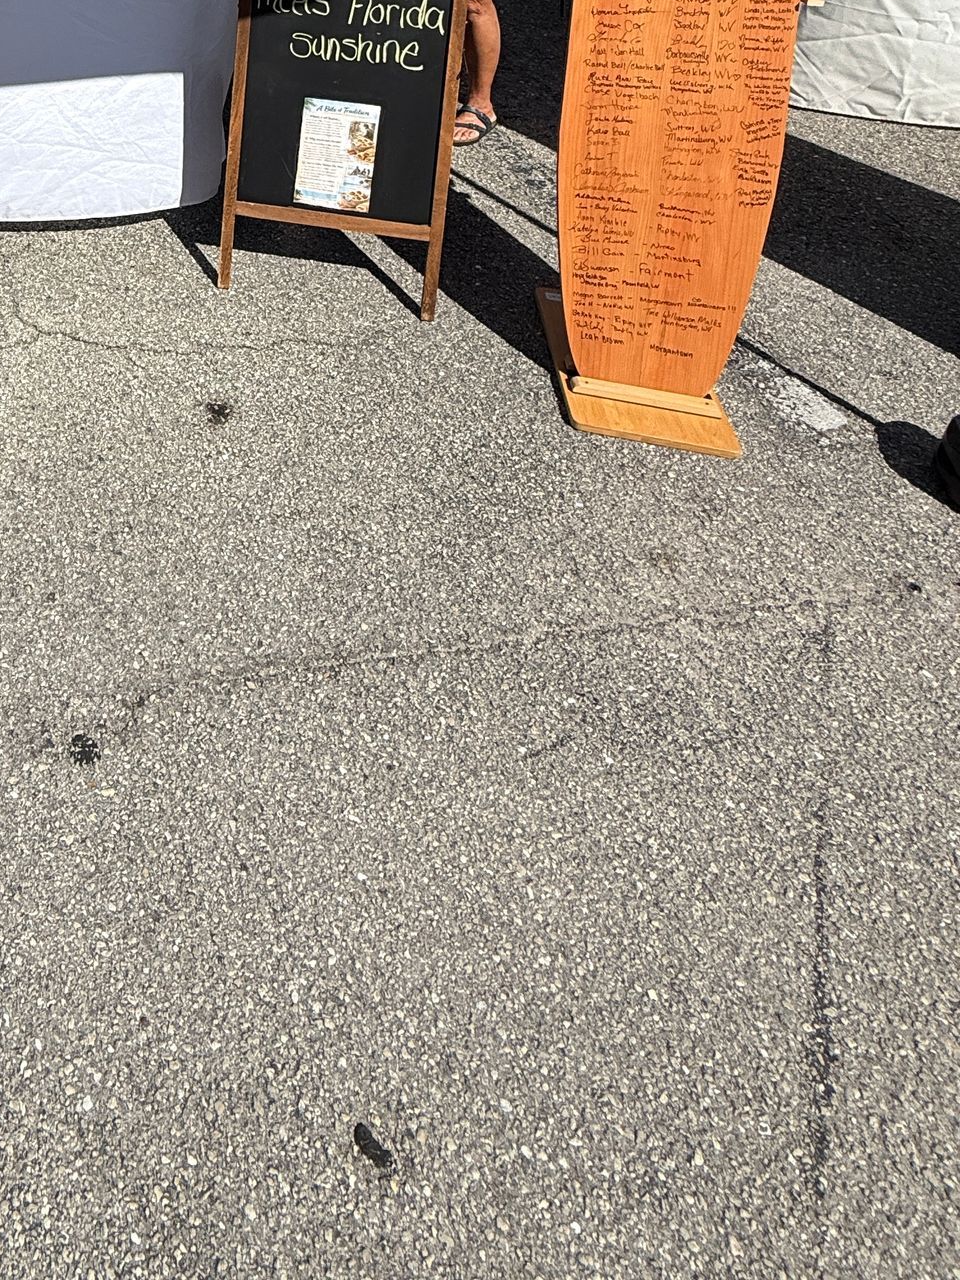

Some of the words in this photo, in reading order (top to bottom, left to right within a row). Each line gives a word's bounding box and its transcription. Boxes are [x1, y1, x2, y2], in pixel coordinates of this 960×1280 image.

[646, 251, 702, 268] Martinsburg
[638, 262, 695, 282] Fairmont
[580, 330, 600, 342] Leah
[601, 335, 625, 345] Brown
[649, 343, 694, 359] Morgantown
